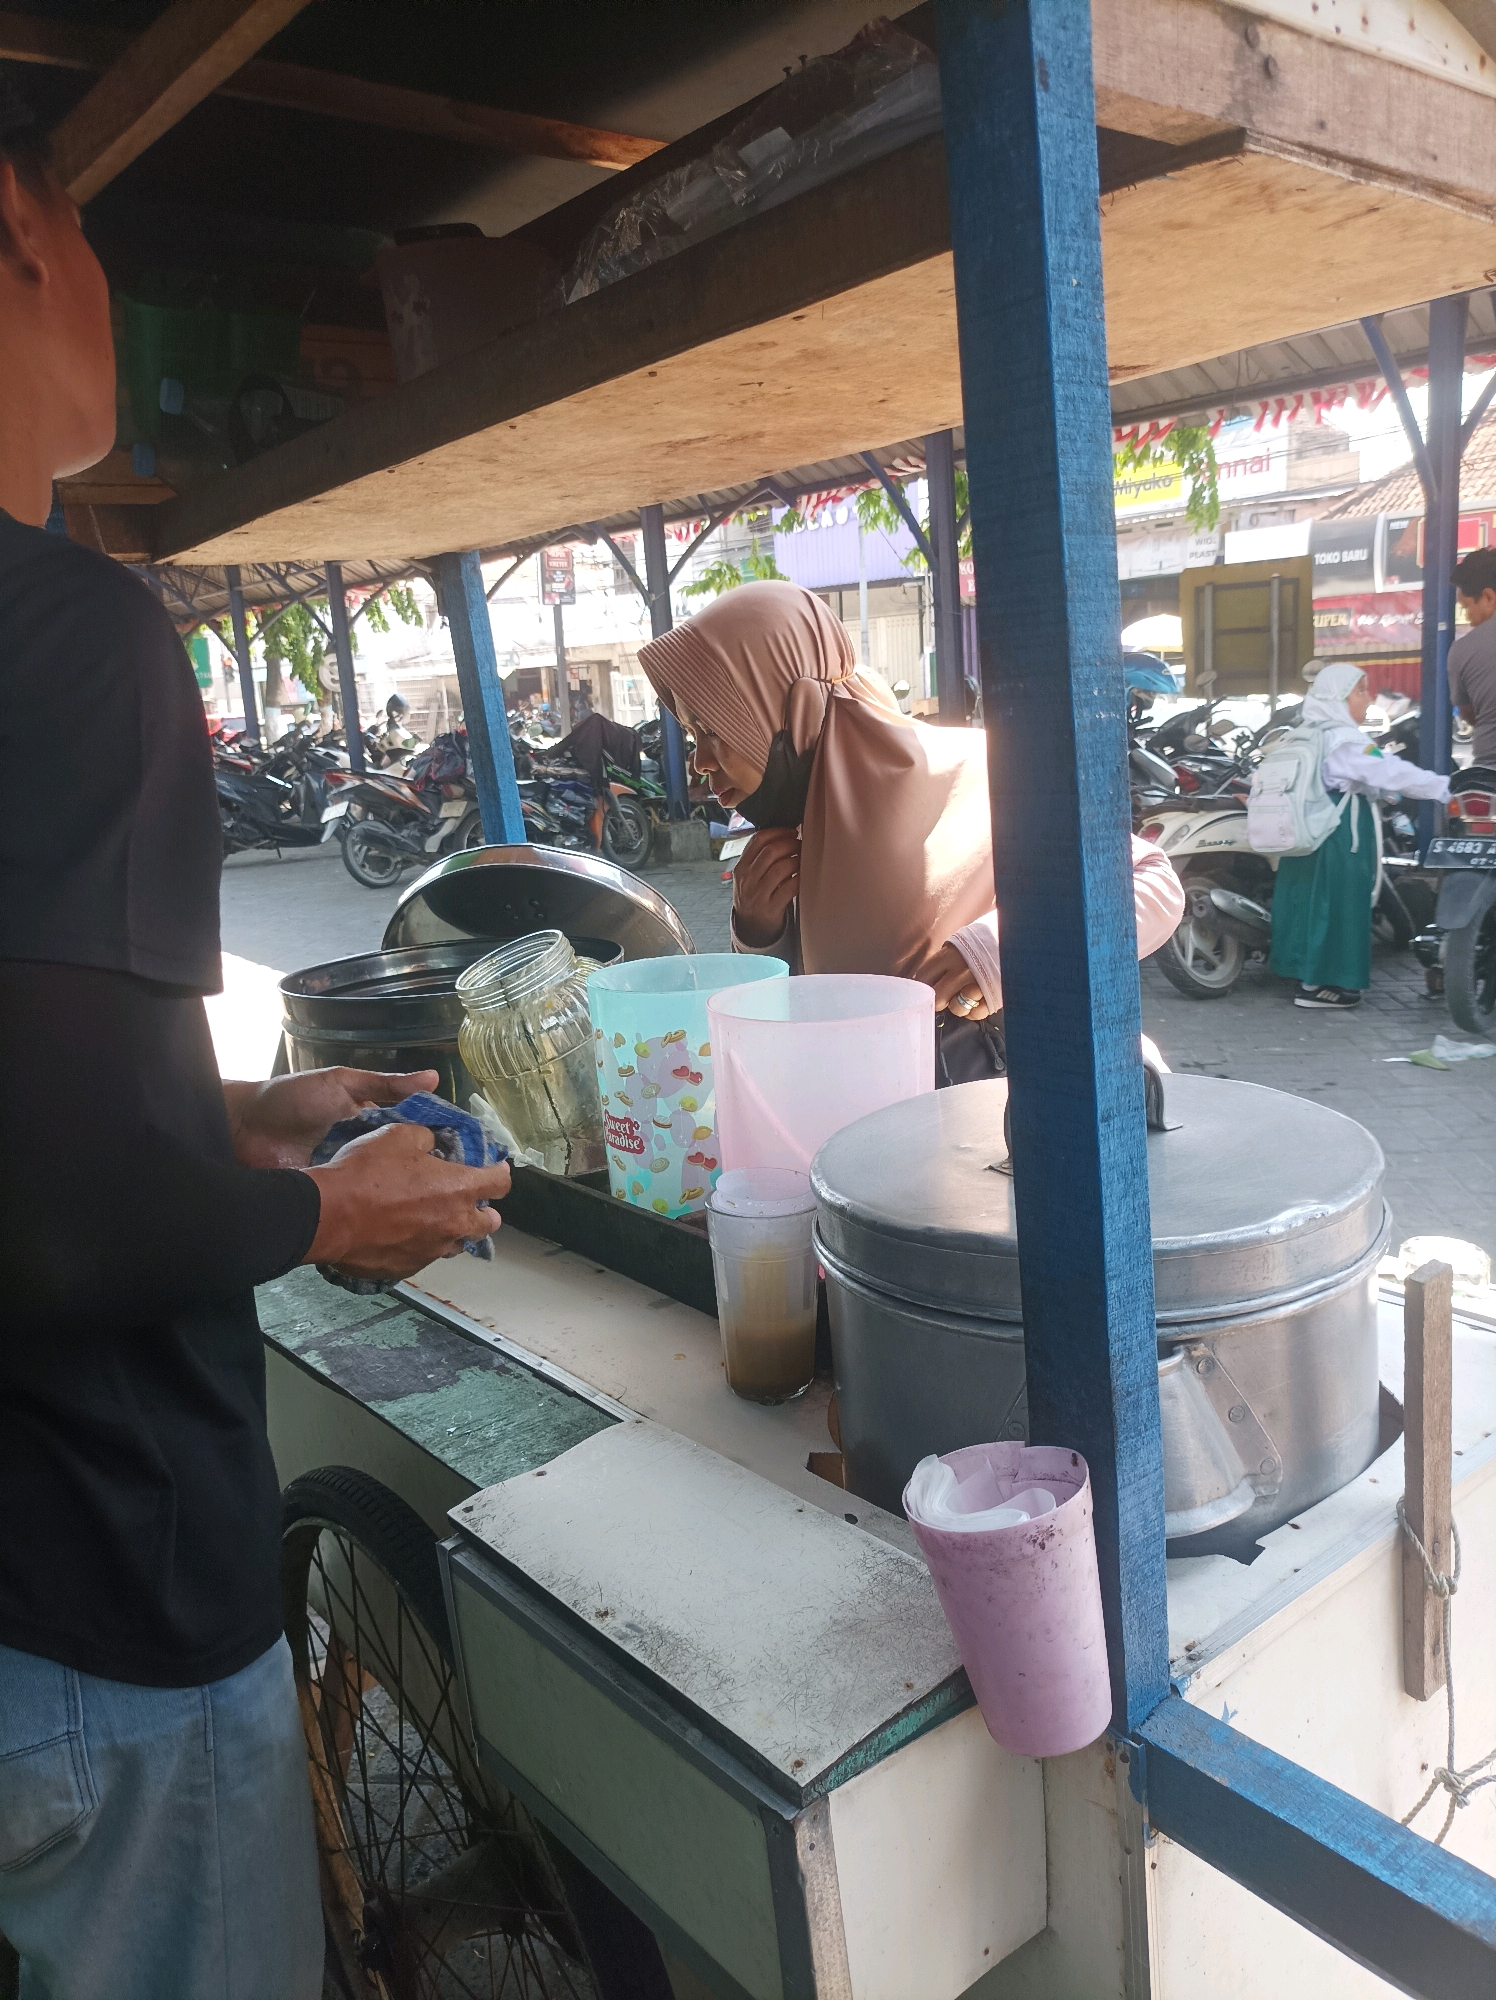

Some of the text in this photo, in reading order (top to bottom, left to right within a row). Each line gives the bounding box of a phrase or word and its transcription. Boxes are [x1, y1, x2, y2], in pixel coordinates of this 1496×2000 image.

[1195, 448, 1271, 484] nnai
[1113, 473, 1173, 499] Miyako
[1314, 548, 1369, 566] TOKO BARU
[1432, 840, 1444, 853] S
[605, 1113, 631, 1135] Sweet
